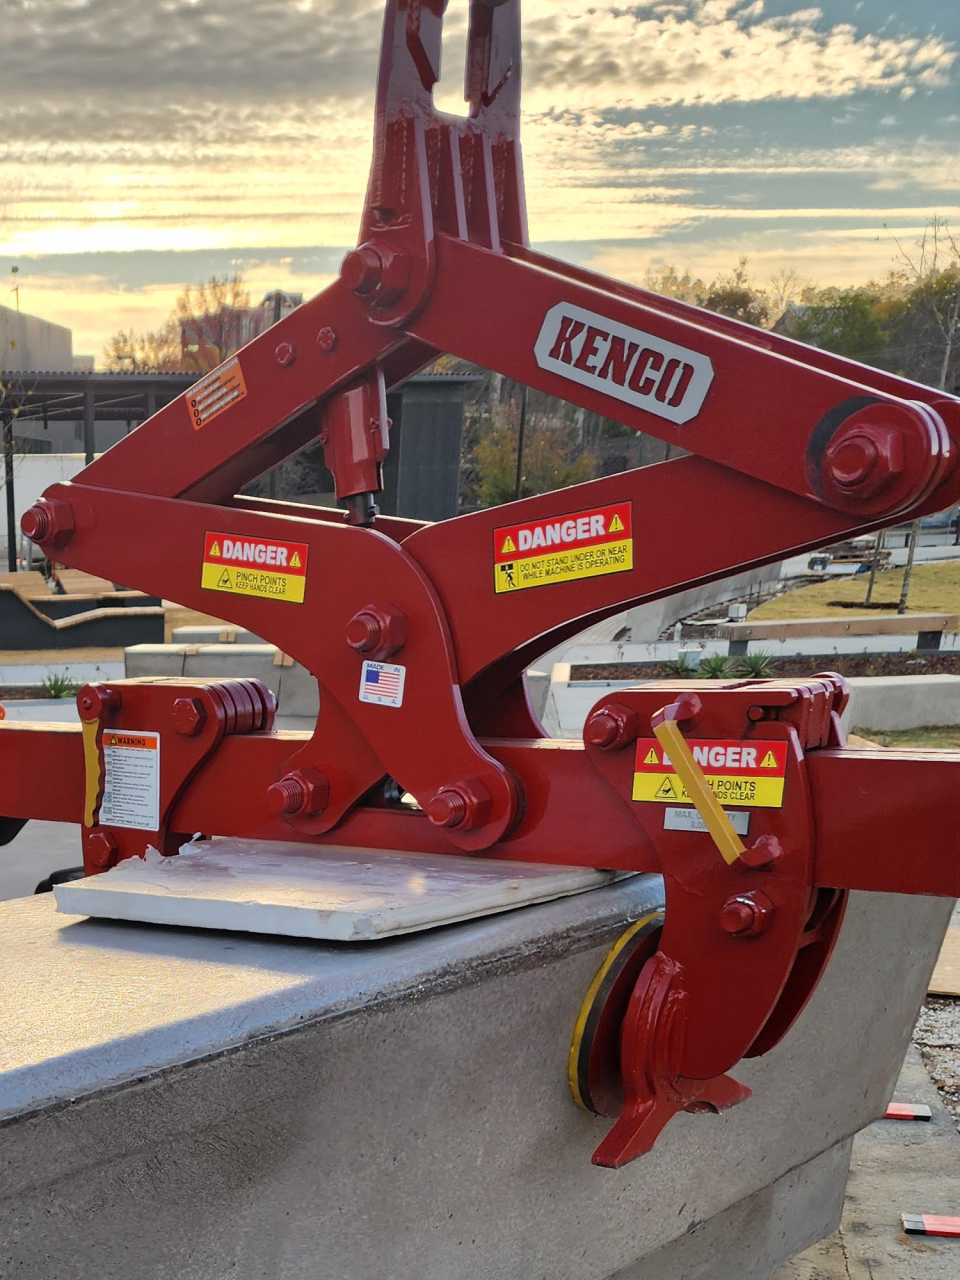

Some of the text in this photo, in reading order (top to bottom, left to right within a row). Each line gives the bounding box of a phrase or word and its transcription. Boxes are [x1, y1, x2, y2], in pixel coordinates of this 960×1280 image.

[548, 315, 694, 408] KENCO
[518, 514, 605, 551] DANGER
[222, 540, 288, 566] DANGER
[520, 545, 627, 572] DO NOT STAND UNDER OR NEAR
[236, 571, 287, 587] PINCH POINTS
[523, 570, 542, 580] WHILE
[545, 564, 577, 577] MACHINE
[585, 555, 625, 569] OPERATING
[717, 780, 757, 792] POINTS
[730, 792, 755, 801] CLEAR
